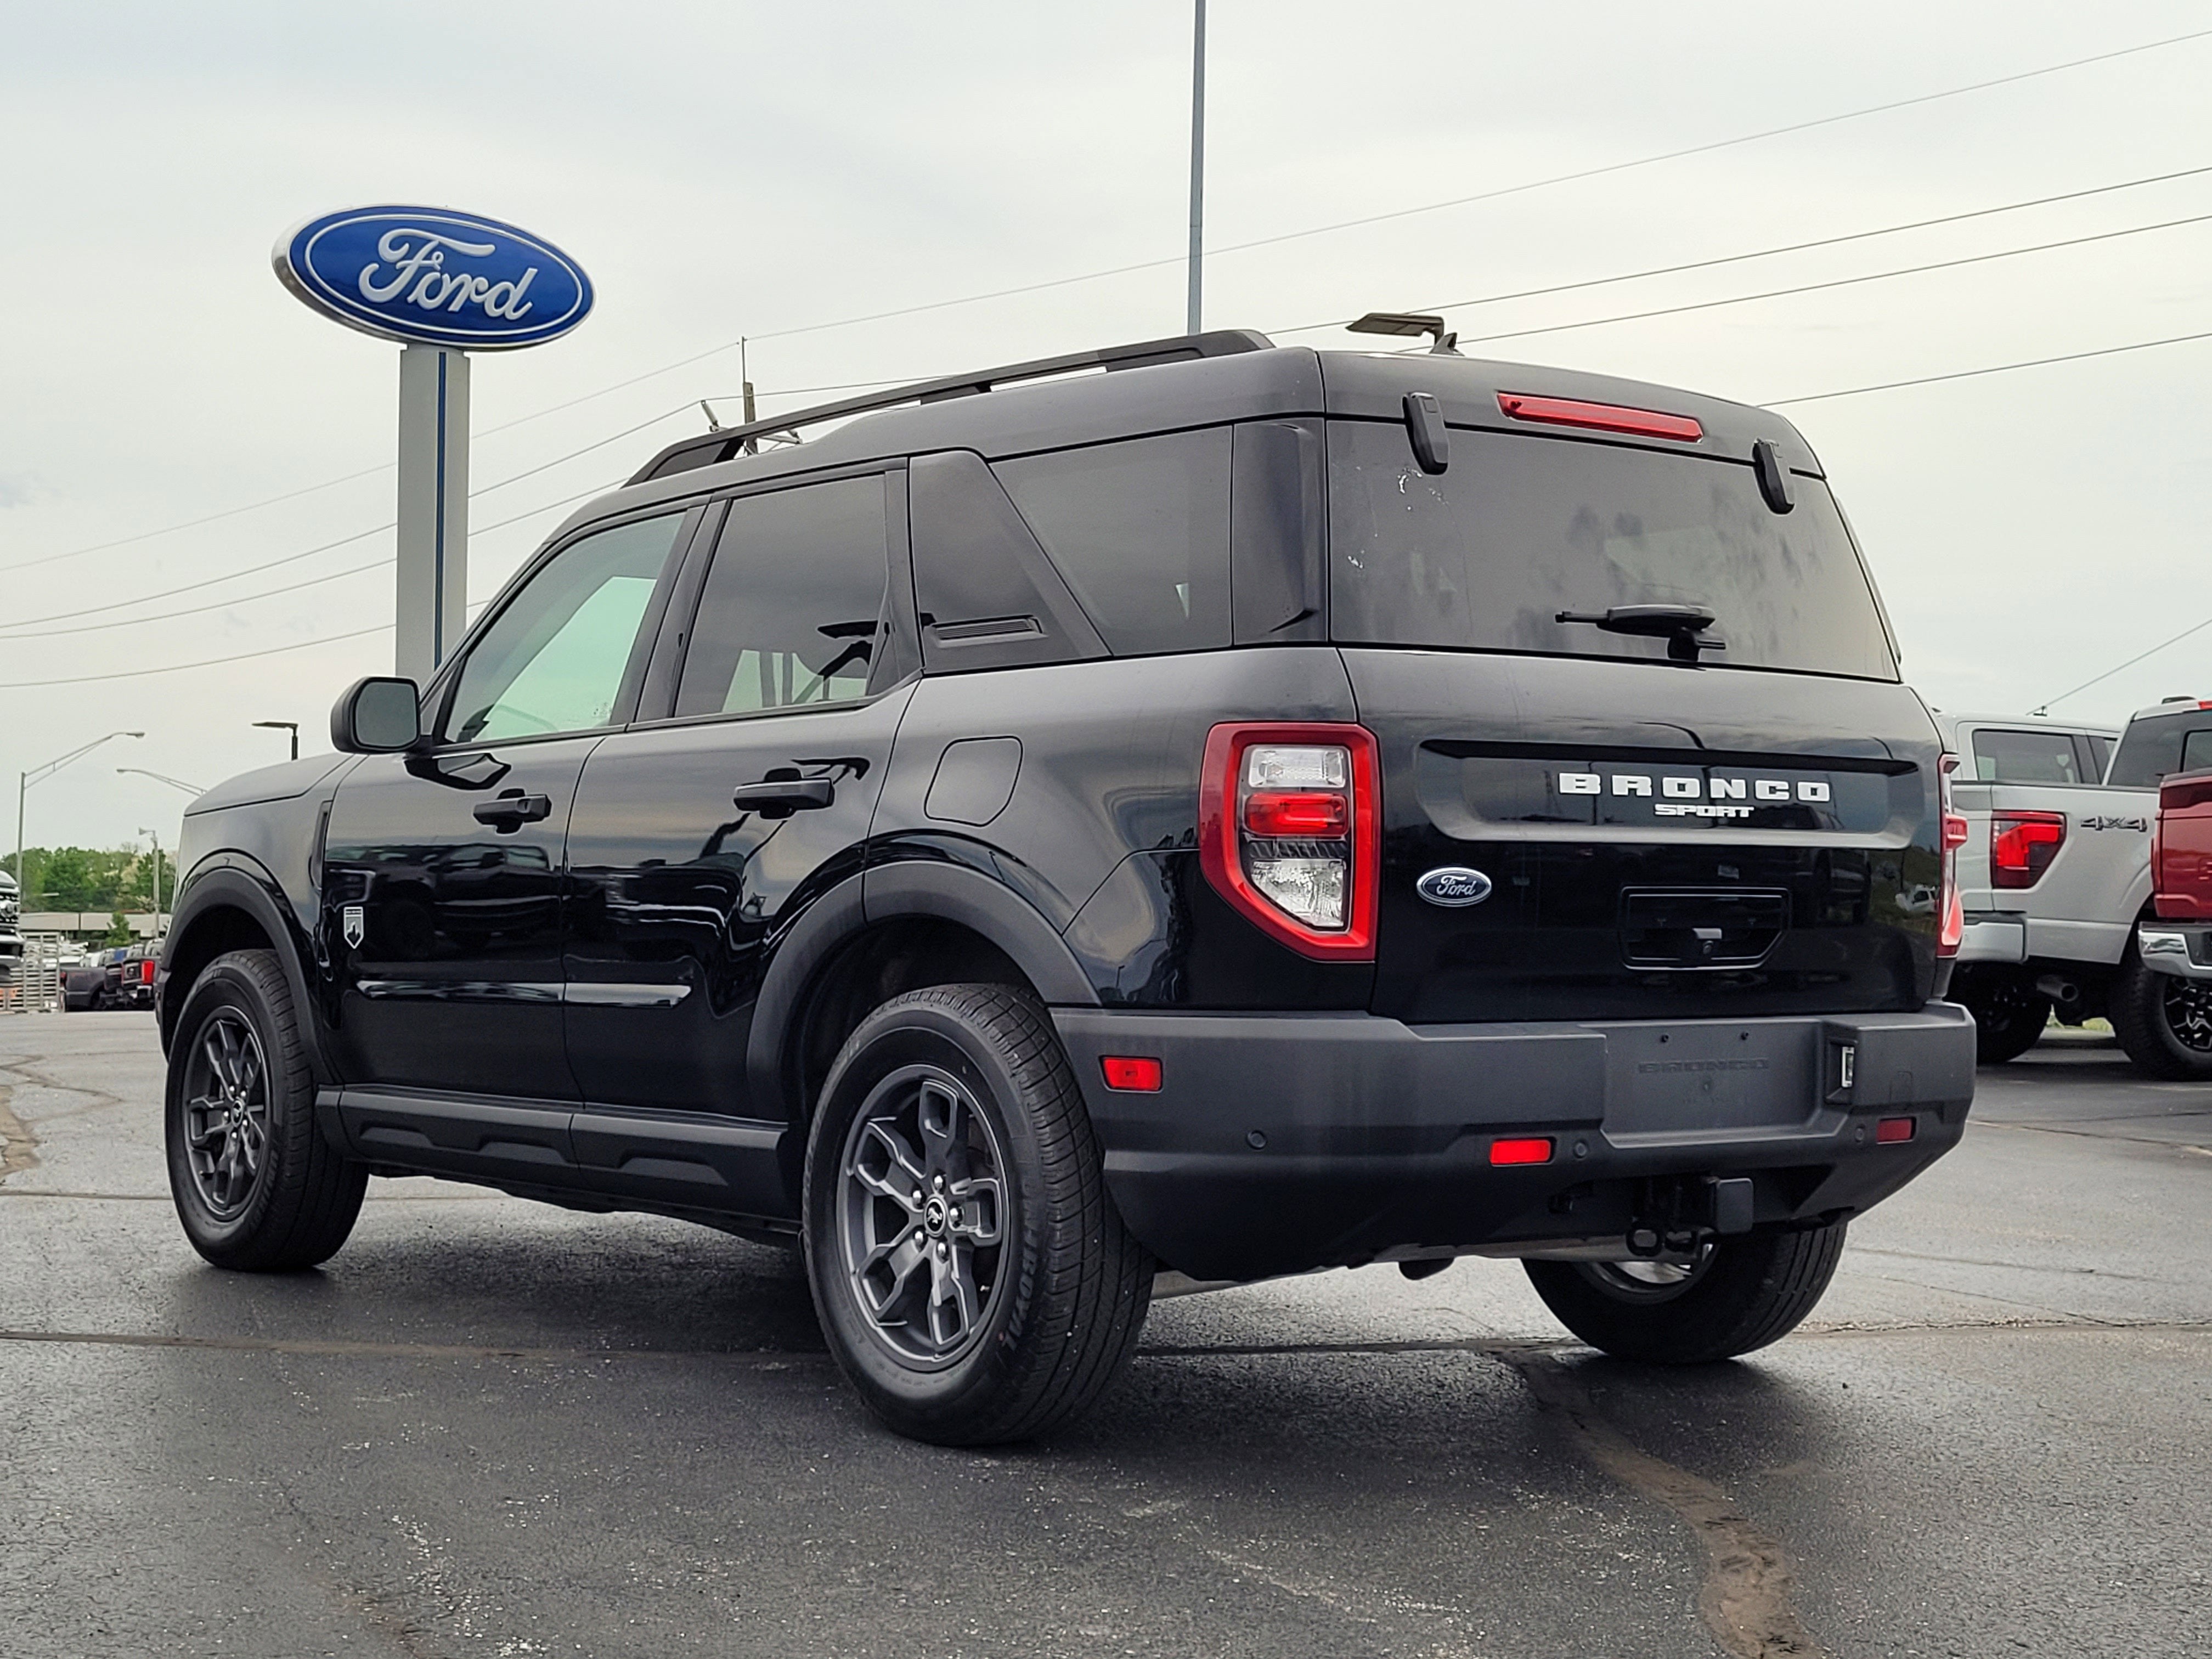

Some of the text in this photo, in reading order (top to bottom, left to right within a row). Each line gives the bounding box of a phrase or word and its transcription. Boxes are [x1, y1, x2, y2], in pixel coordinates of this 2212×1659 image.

[358, 228, 538, 321] Ford
[1559, 772, 1830, 802] BRONCO
[1655, 803, 1754, 817] SPORT
[1436, 875, 1477, 895] Ford
